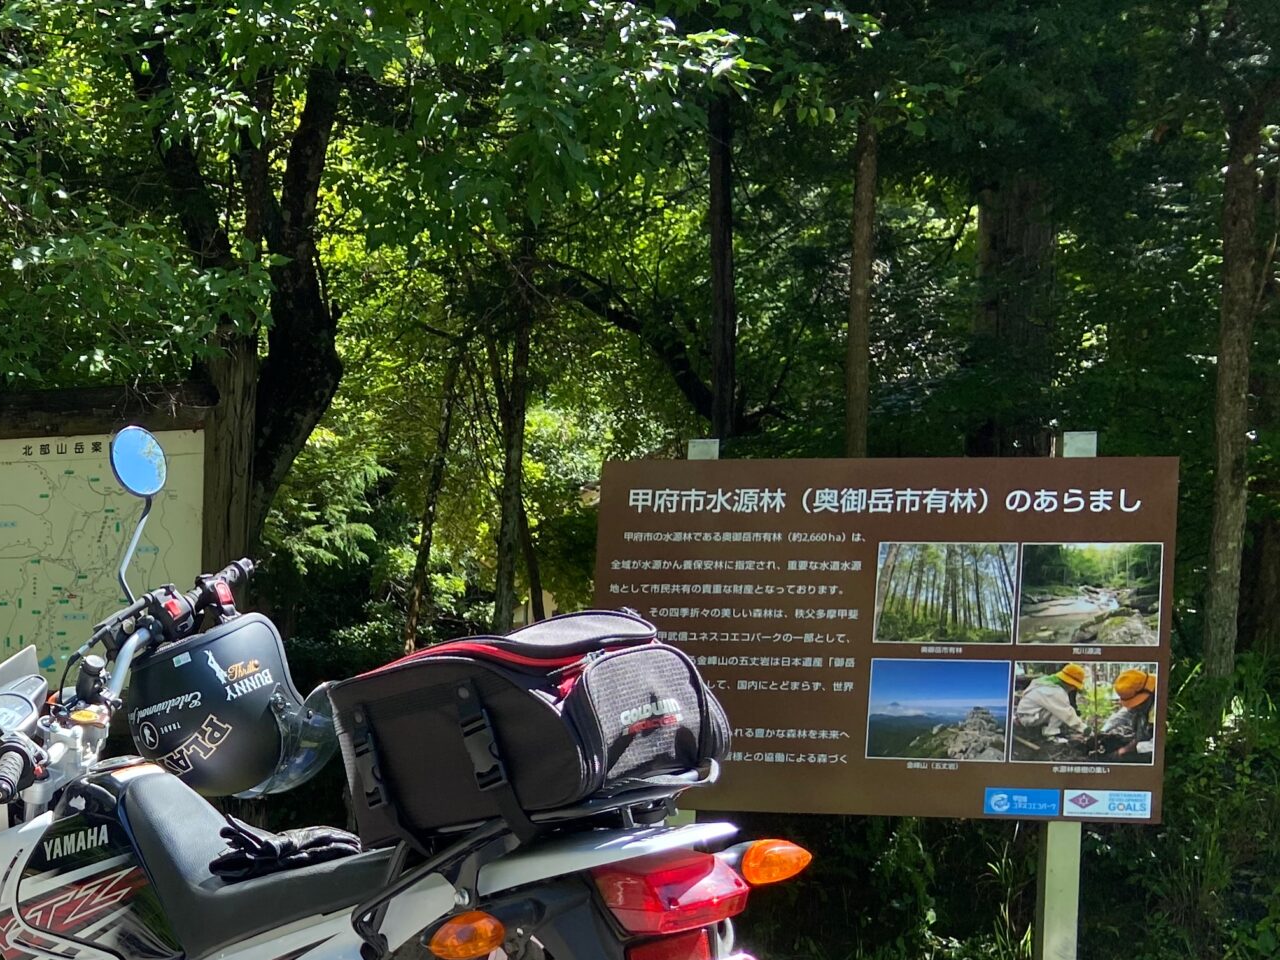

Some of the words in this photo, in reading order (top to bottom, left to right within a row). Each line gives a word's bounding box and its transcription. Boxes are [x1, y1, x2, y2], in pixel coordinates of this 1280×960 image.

[22, 441, 112, 457] 北部山岳案
[628, 487, 1142, 514] 甲府市水源林（奥御岳市有林）のあらまし
[224, 668, 273, 701] BUNNY
[1107, 802, 1147, 812] GOALS
[43, 824, 109, 862] YAMAHA
